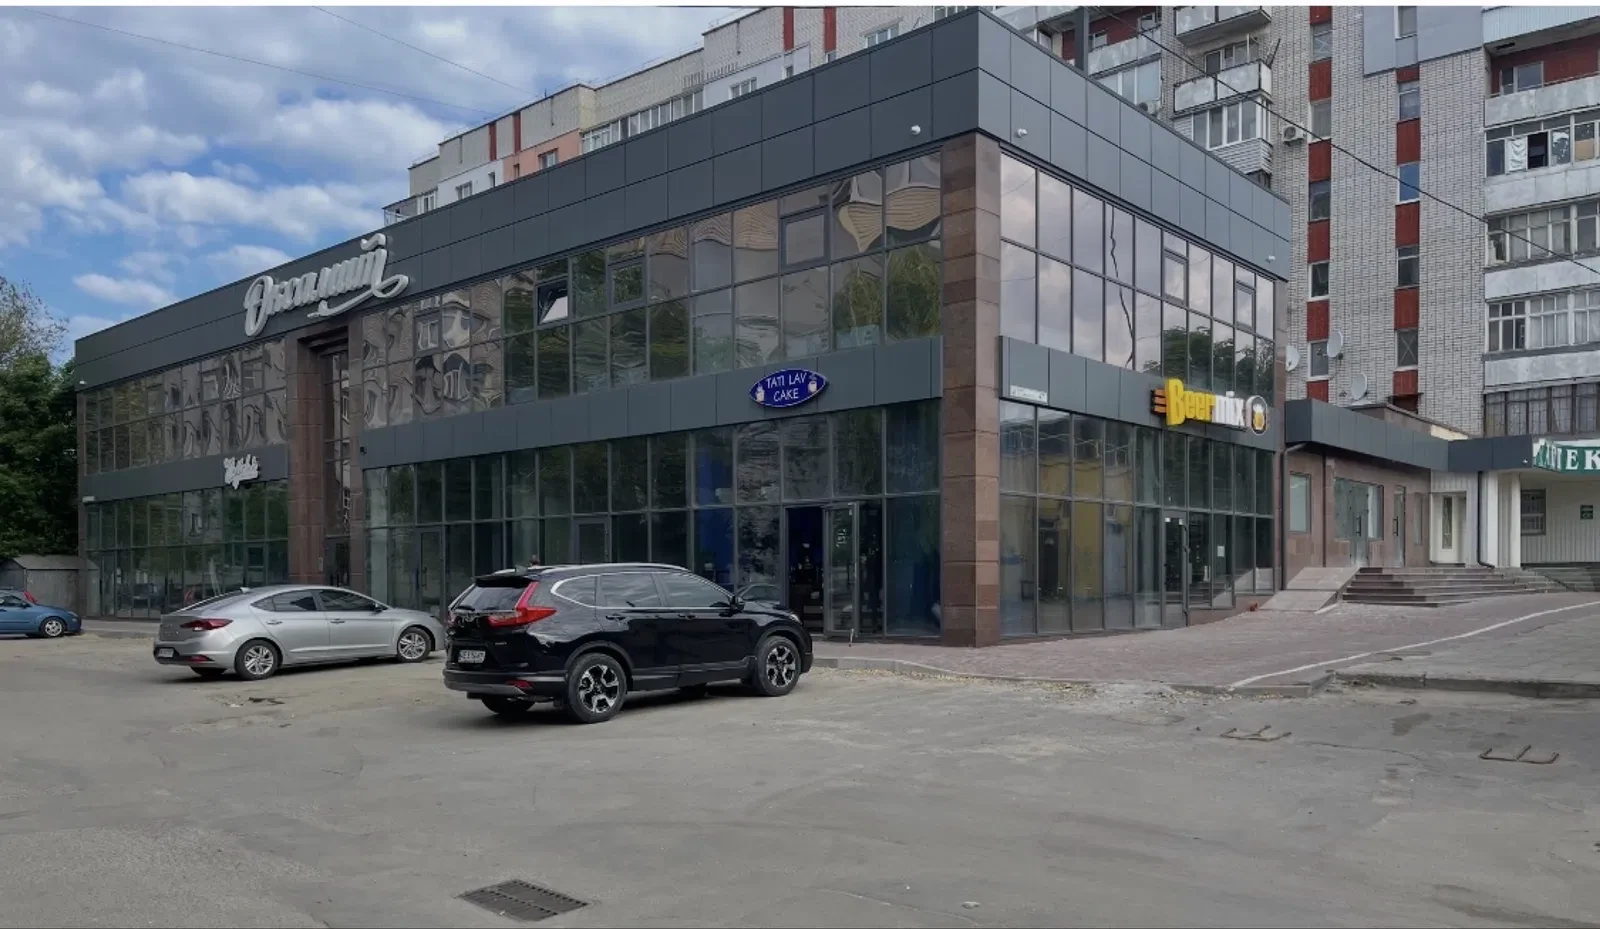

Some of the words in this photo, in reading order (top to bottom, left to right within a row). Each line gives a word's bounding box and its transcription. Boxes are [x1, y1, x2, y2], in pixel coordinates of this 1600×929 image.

[766, 374, 785, 389] TATI
[788, 372, 807, 386] LAV
[773, 387, 799, 402] CAKE
